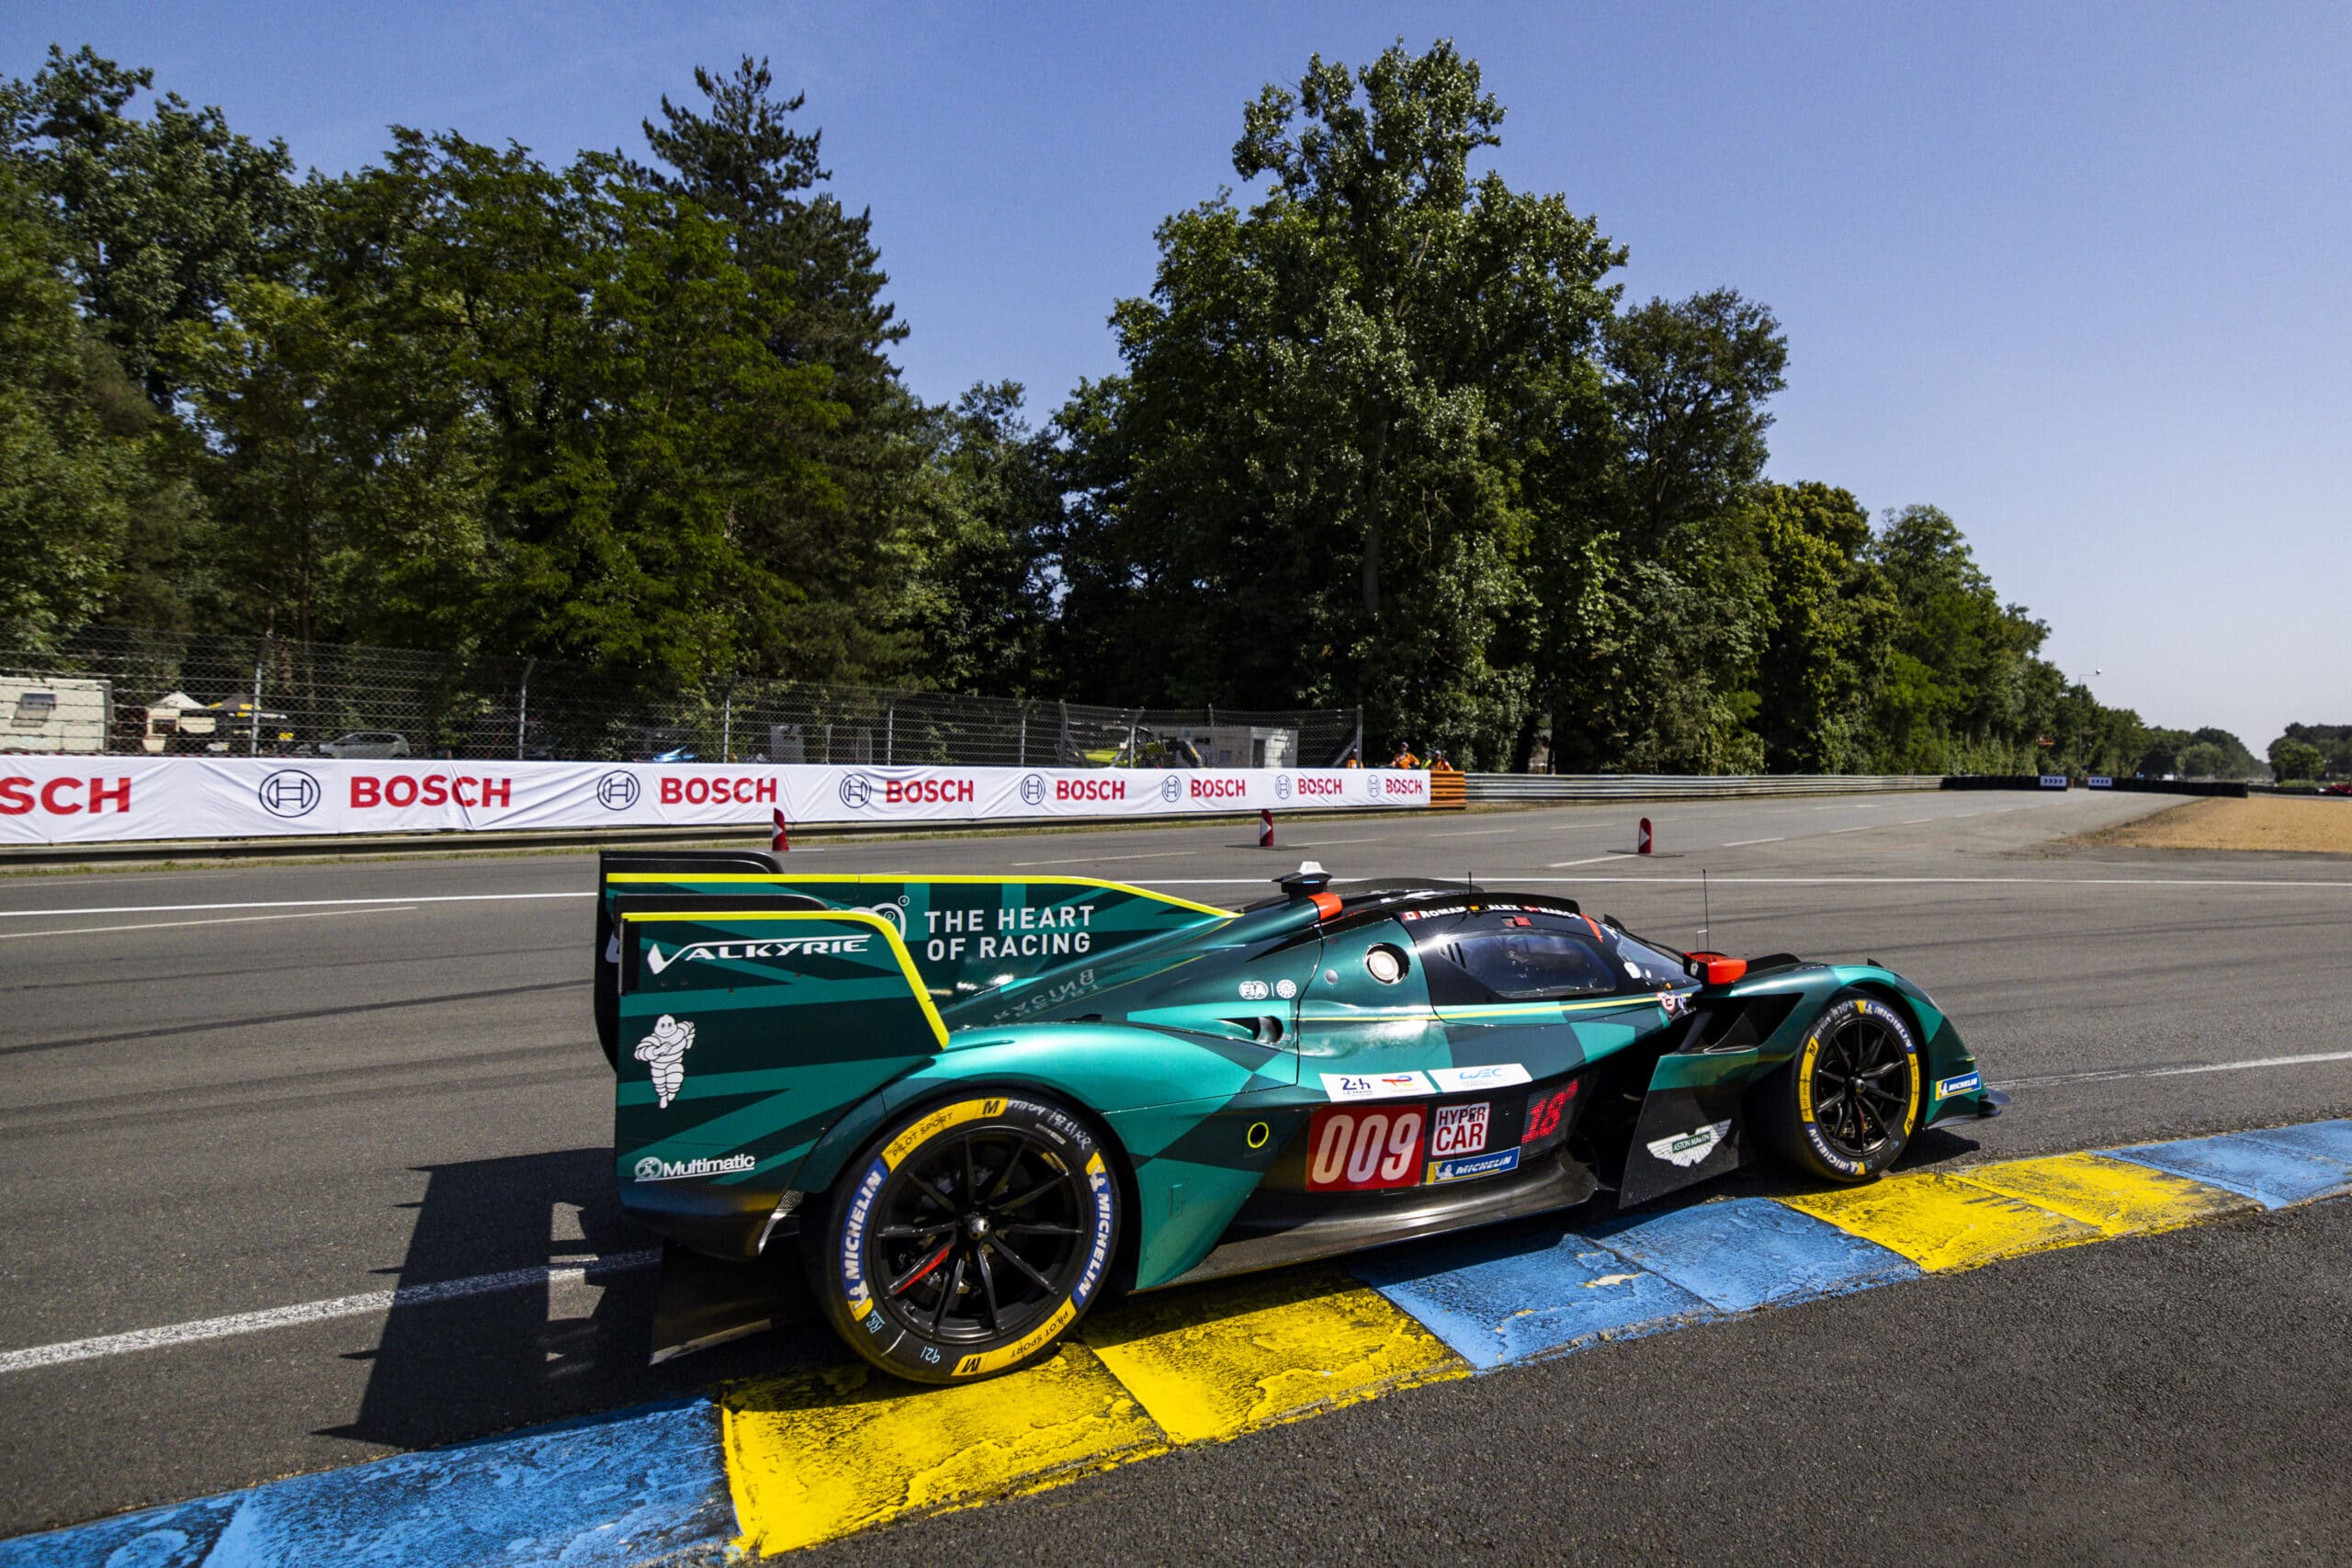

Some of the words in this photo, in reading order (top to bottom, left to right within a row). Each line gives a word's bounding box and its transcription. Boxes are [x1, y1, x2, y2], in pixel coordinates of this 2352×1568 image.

[0, 776, 131, 816] SCH
[349, 774, 511, 808] BOSCH
[661, 777, 776, 805] BOSCH
[886, 779, 974, 803] BOSCH
[1057, 779, 1125, 801] BOSCH
[1191, 779, 1246, 797] BOSCH
[1298, 778, 1342, 795] BOSCH
[1385, 778, 1422, 795] BOSCH
[924, 908, 985, 933] THE
[998, 906, 1095, 930] HEART
[1419, 906, 1467, 919] ROMAN
[647, 934, 872, 975] VALKYRIE
[927, 938, 966, 961] OF
[979, 932, 1091, 958] RACING
[1874, 1005, 1913, 1047] MICHELIN
[1459, 1067, 1504, 1079] WEC
[1948, 1077, 1978, 1091] MICHELIN
[982, 1100, 1001, 1115] M
[1438, 1105, 1487, 1126] HYPER
[892, 1131, 918, 1157] PILOT
[921, 1111, 953, 1135] SPORT
[1436, 1122, 1485, 1152] CAR
[1673, 1139, 1690, 1152] ASTON
[1690, 1133, 1711, 1145] MARTIN
[1312, 1112, 1421, 1184] 009
[1807, 1127, 1849, 1170] MICHELIN
[663, 1153, 755, 1177] Multimatic
[1455, 1156, 1513, 1176] MICHELIN
[844, 1170, 883, 1280] MICHELIN
[1079, 1193, 1111, 1297] MICHELIN
[1044, 1310, 1069, 1341] PILOT
[920, 1345, 941, 1365] 921
[1010, 1334, 1043, 1359] SPORT
[961, 1357, 982, 1373] M
